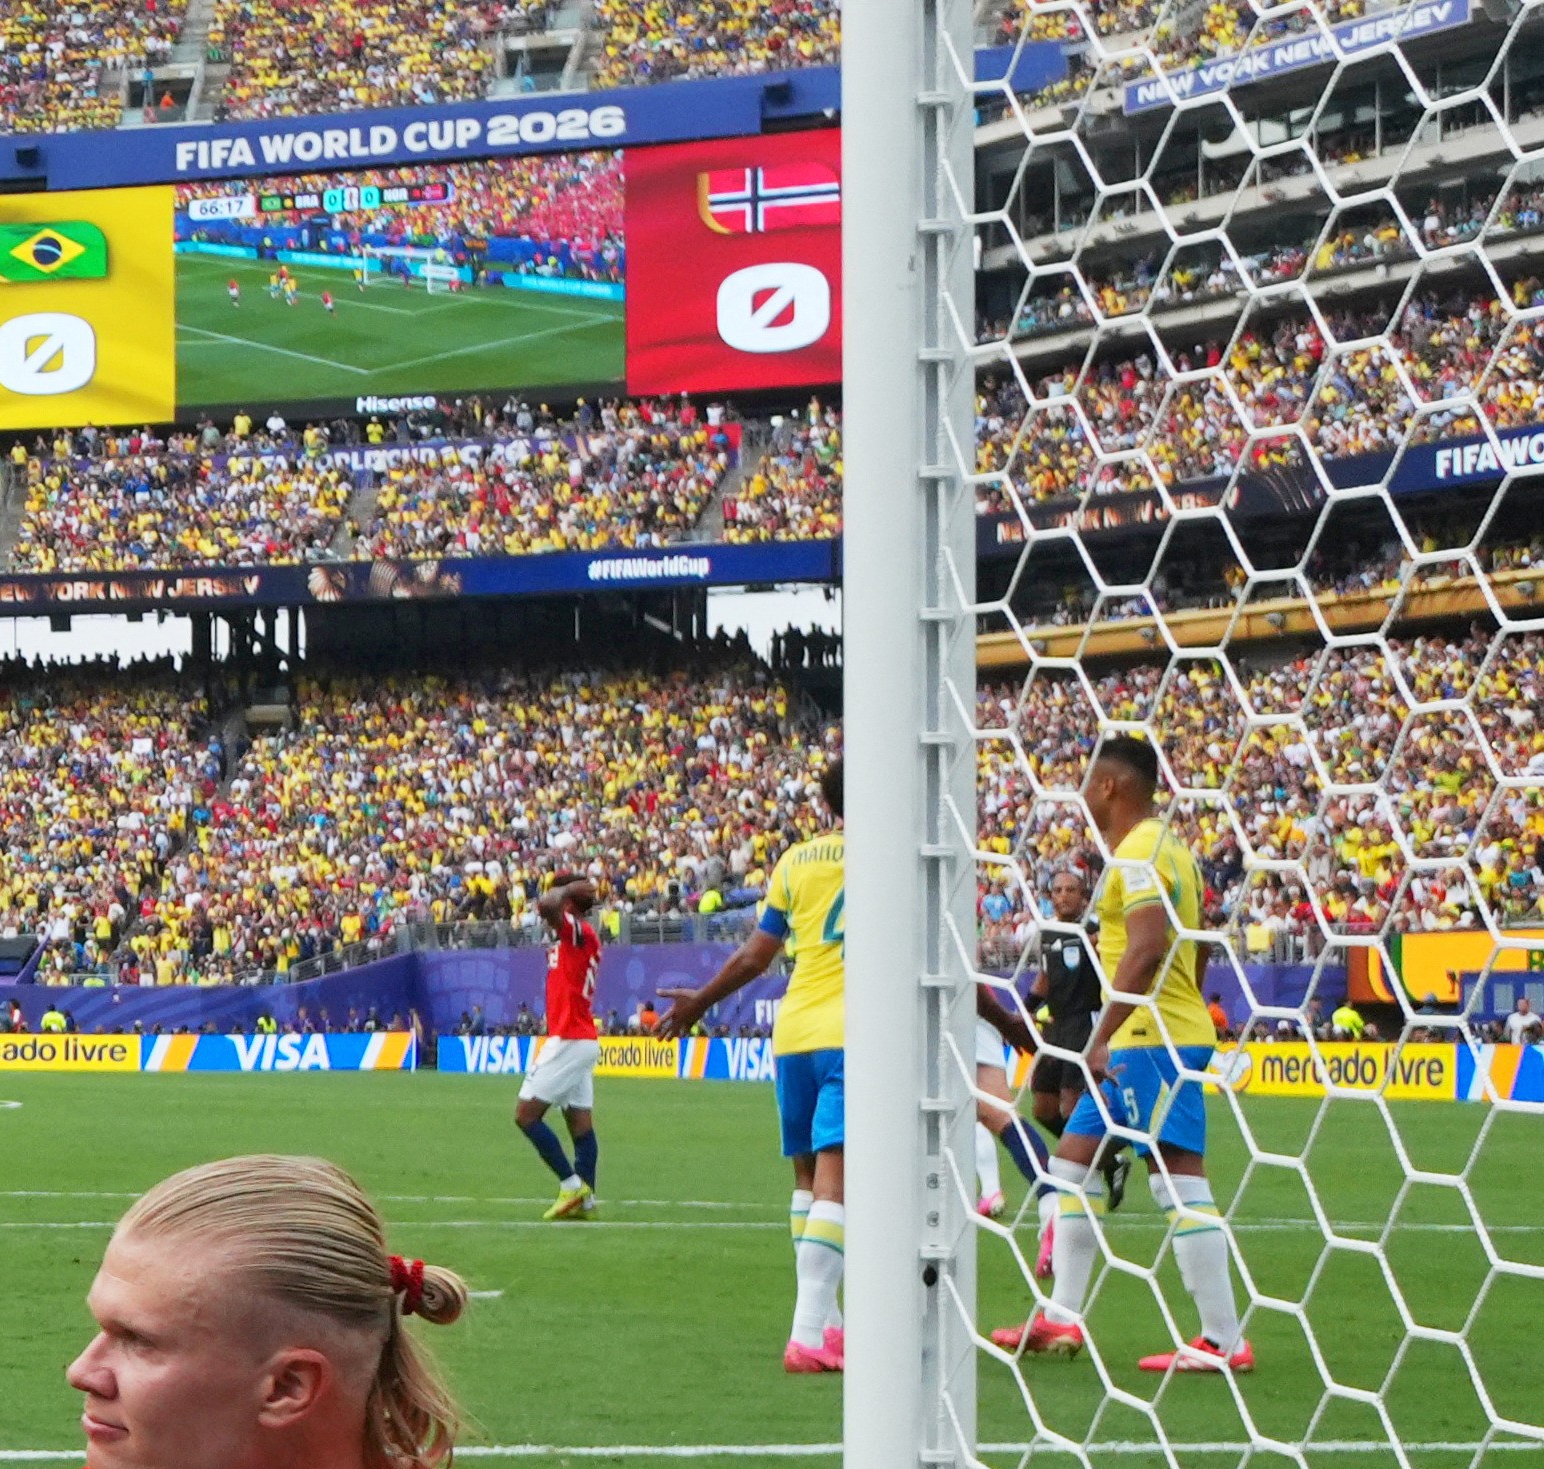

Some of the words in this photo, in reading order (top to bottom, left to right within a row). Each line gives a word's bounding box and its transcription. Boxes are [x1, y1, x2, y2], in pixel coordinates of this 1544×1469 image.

[175, 138, 255, 171] FIFA
[259, 125, 398, 164] WORLD
[403, 119, 482, 154] CUP
[486, 105, 627, 145] 2026
[199, 199, 244, 216] 66:17
[356, 395, 437, 414] Hisense
[1435, 441, 1499, 480] FIFA
[587, 554, 710, 581] #FIFAWorldCup
[64, 1038, 128, 1062] livre
[224, 1033, 331, 1071] VISA
[458, 1036, 521, 1073] VISA
[596, 1042, 641, 1067] ercado
[643, 1039, 674, 1067] livre
[721, 1037, 777, 1080] VISA
[1123, 1088, 1140, 1125] 5
